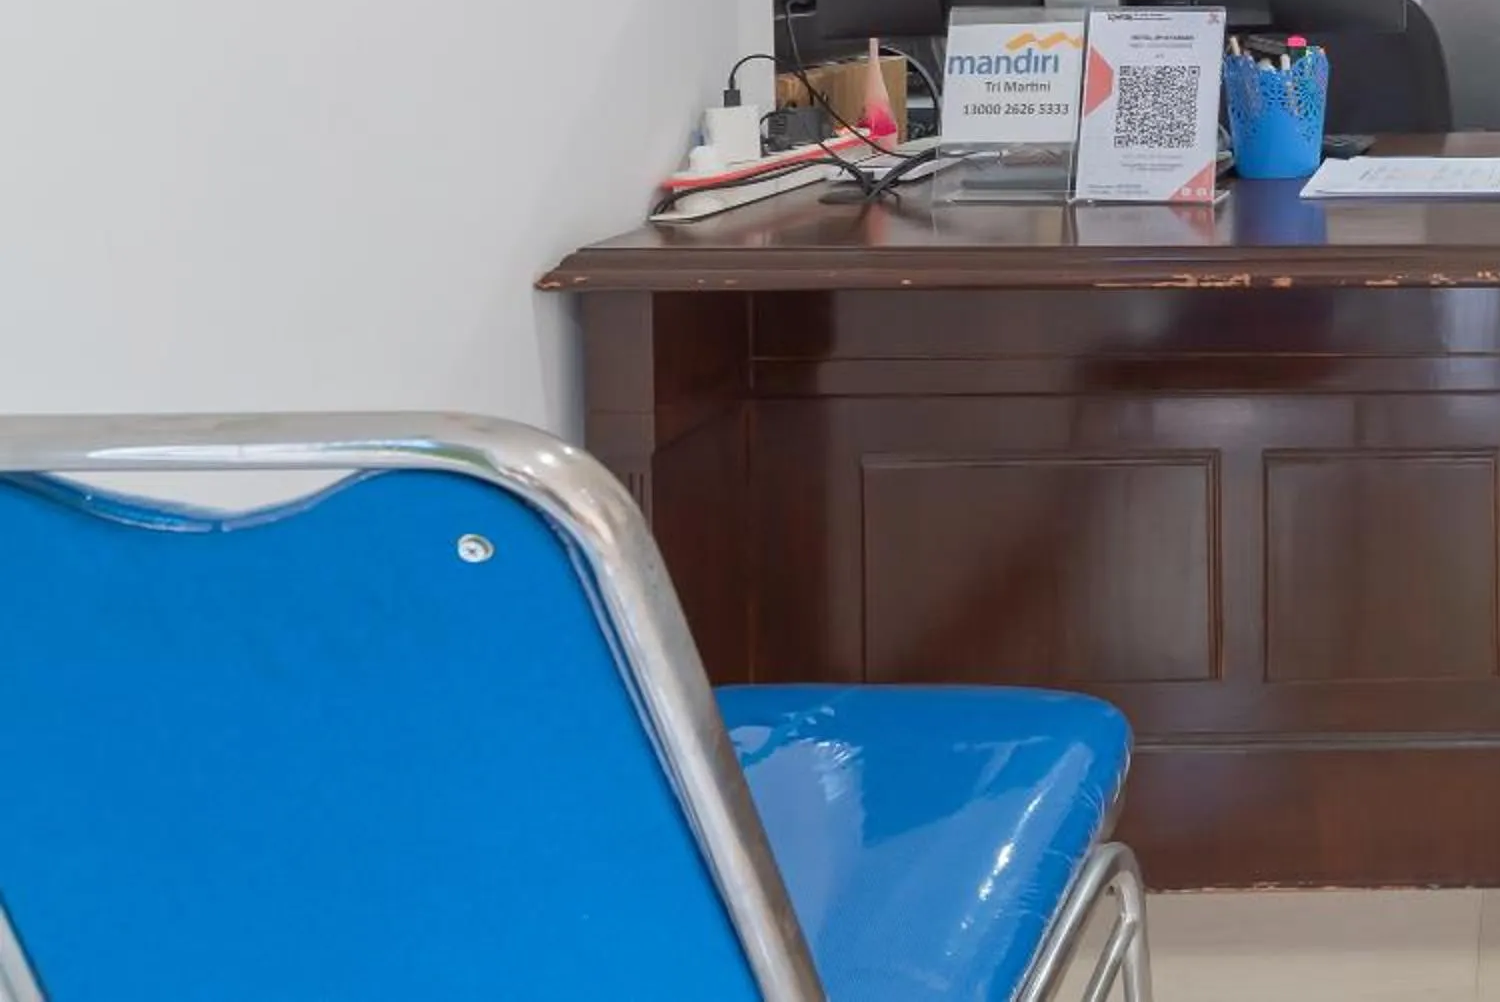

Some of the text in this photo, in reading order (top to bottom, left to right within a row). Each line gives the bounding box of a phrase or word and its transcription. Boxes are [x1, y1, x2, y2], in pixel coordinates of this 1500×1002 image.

[947, 47, 1059, 75] mandiri
[985, 80, 1051, 93] Tri Martini
[963, 103, 1070, 115] 13000 2626 5333
